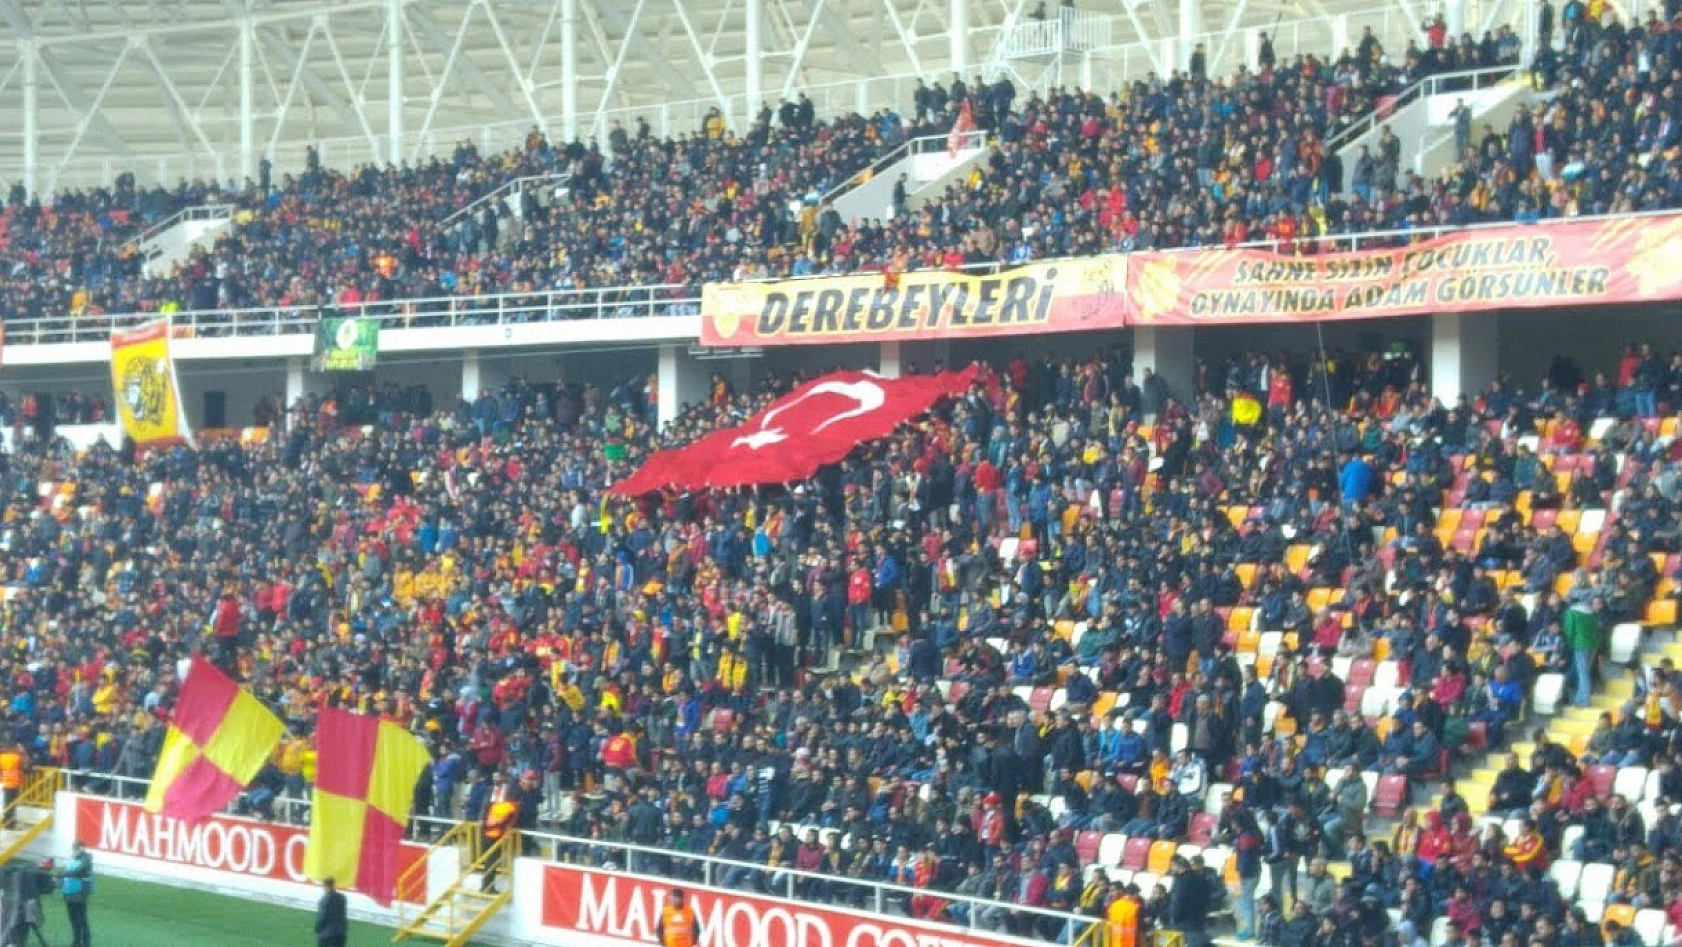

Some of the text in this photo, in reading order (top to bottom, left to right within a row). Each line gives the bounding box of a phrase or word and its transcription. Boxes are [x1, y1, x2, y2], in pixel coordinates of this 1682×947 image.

[1191, 266, 1610, 315] OYNAYINDA ADAM GÖRSÜNLER
[99, 803, 276, 875] MAHMOOD
